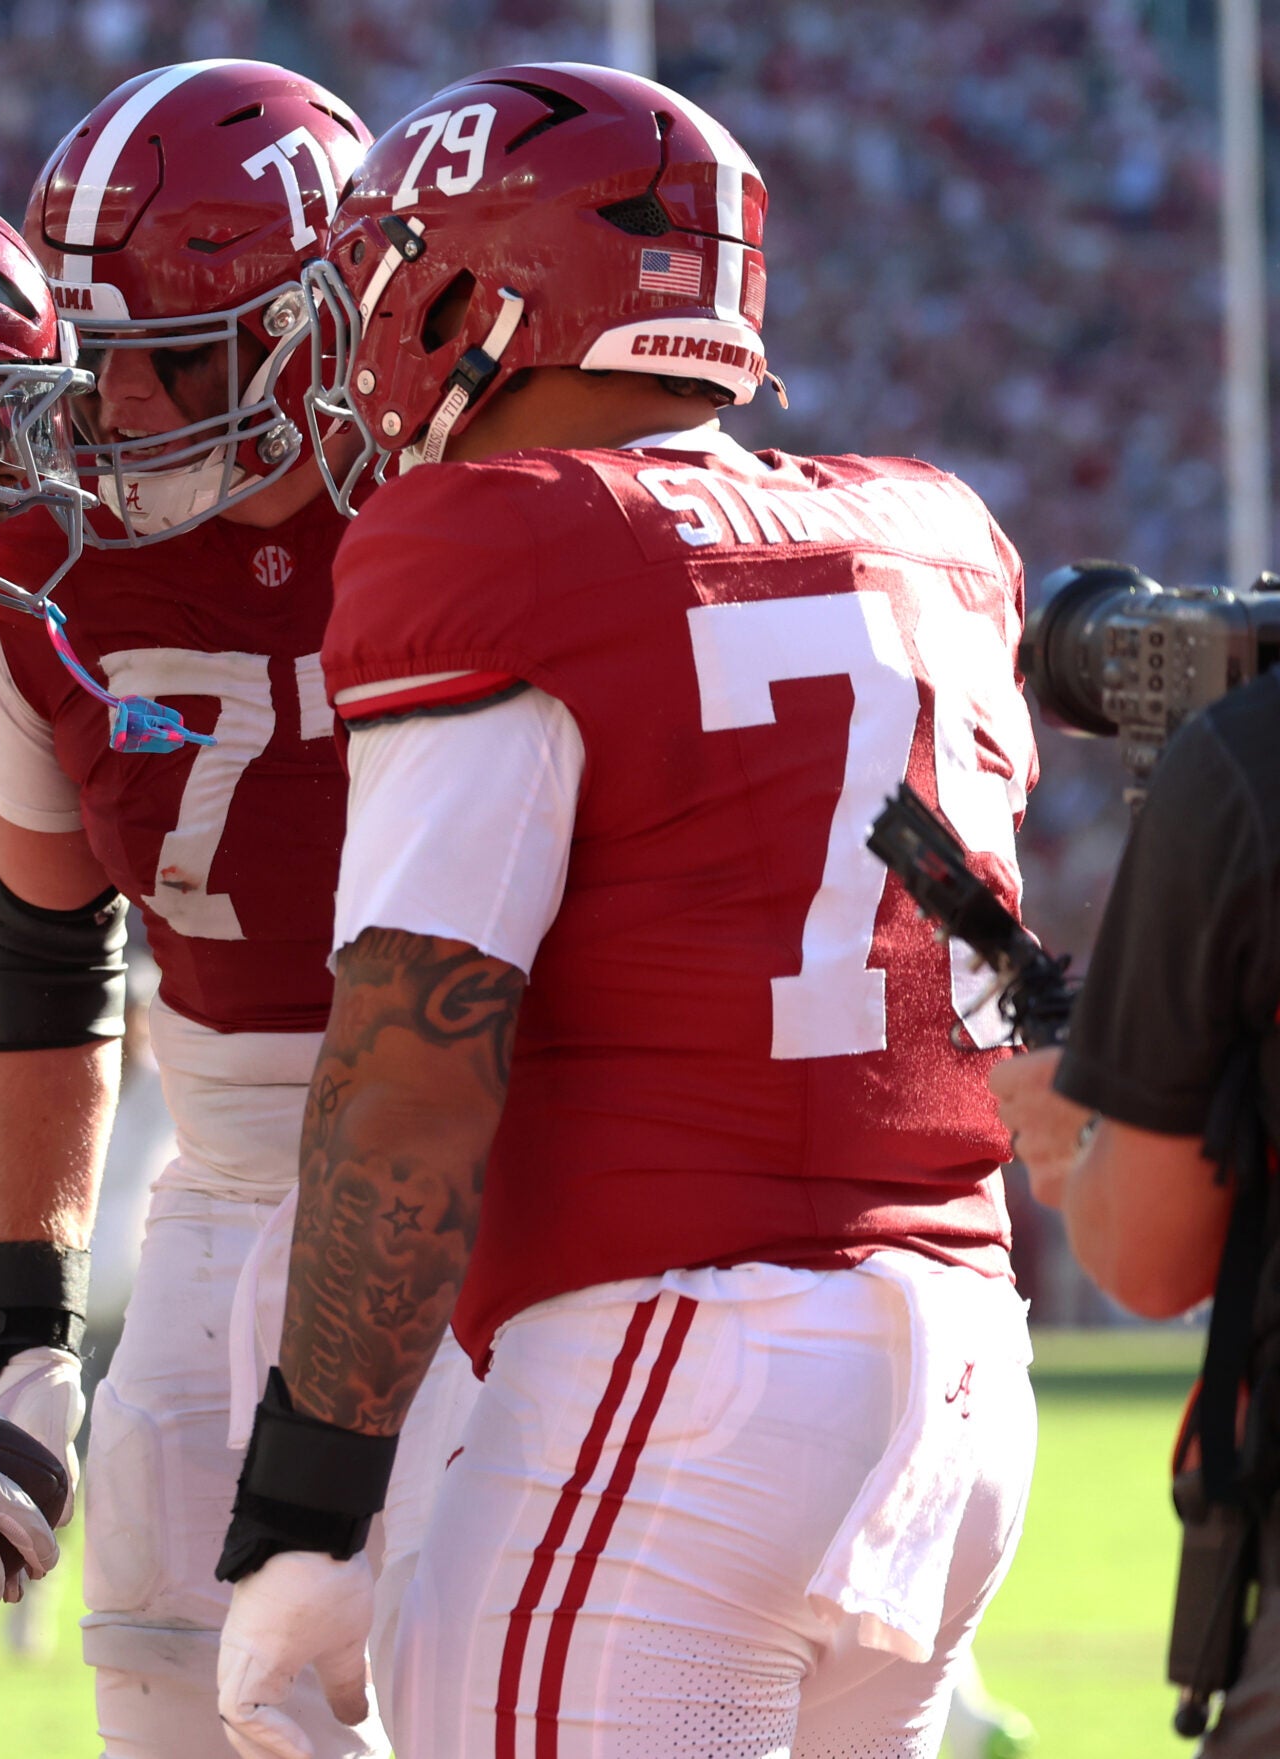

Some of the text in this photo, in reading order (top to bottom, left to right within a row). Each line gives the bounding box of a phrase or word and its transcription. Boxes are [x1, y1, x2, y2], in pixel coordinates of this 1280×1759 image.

[241, 126, 338, 252] 77
[392, 103, 498, 212] 79
[54, 286, 93, 310] AMA
[631, 335, 747, 369] CRIMSON
[251, 545, 293, 587] SEC
[100, 647, 335, 941] 7
